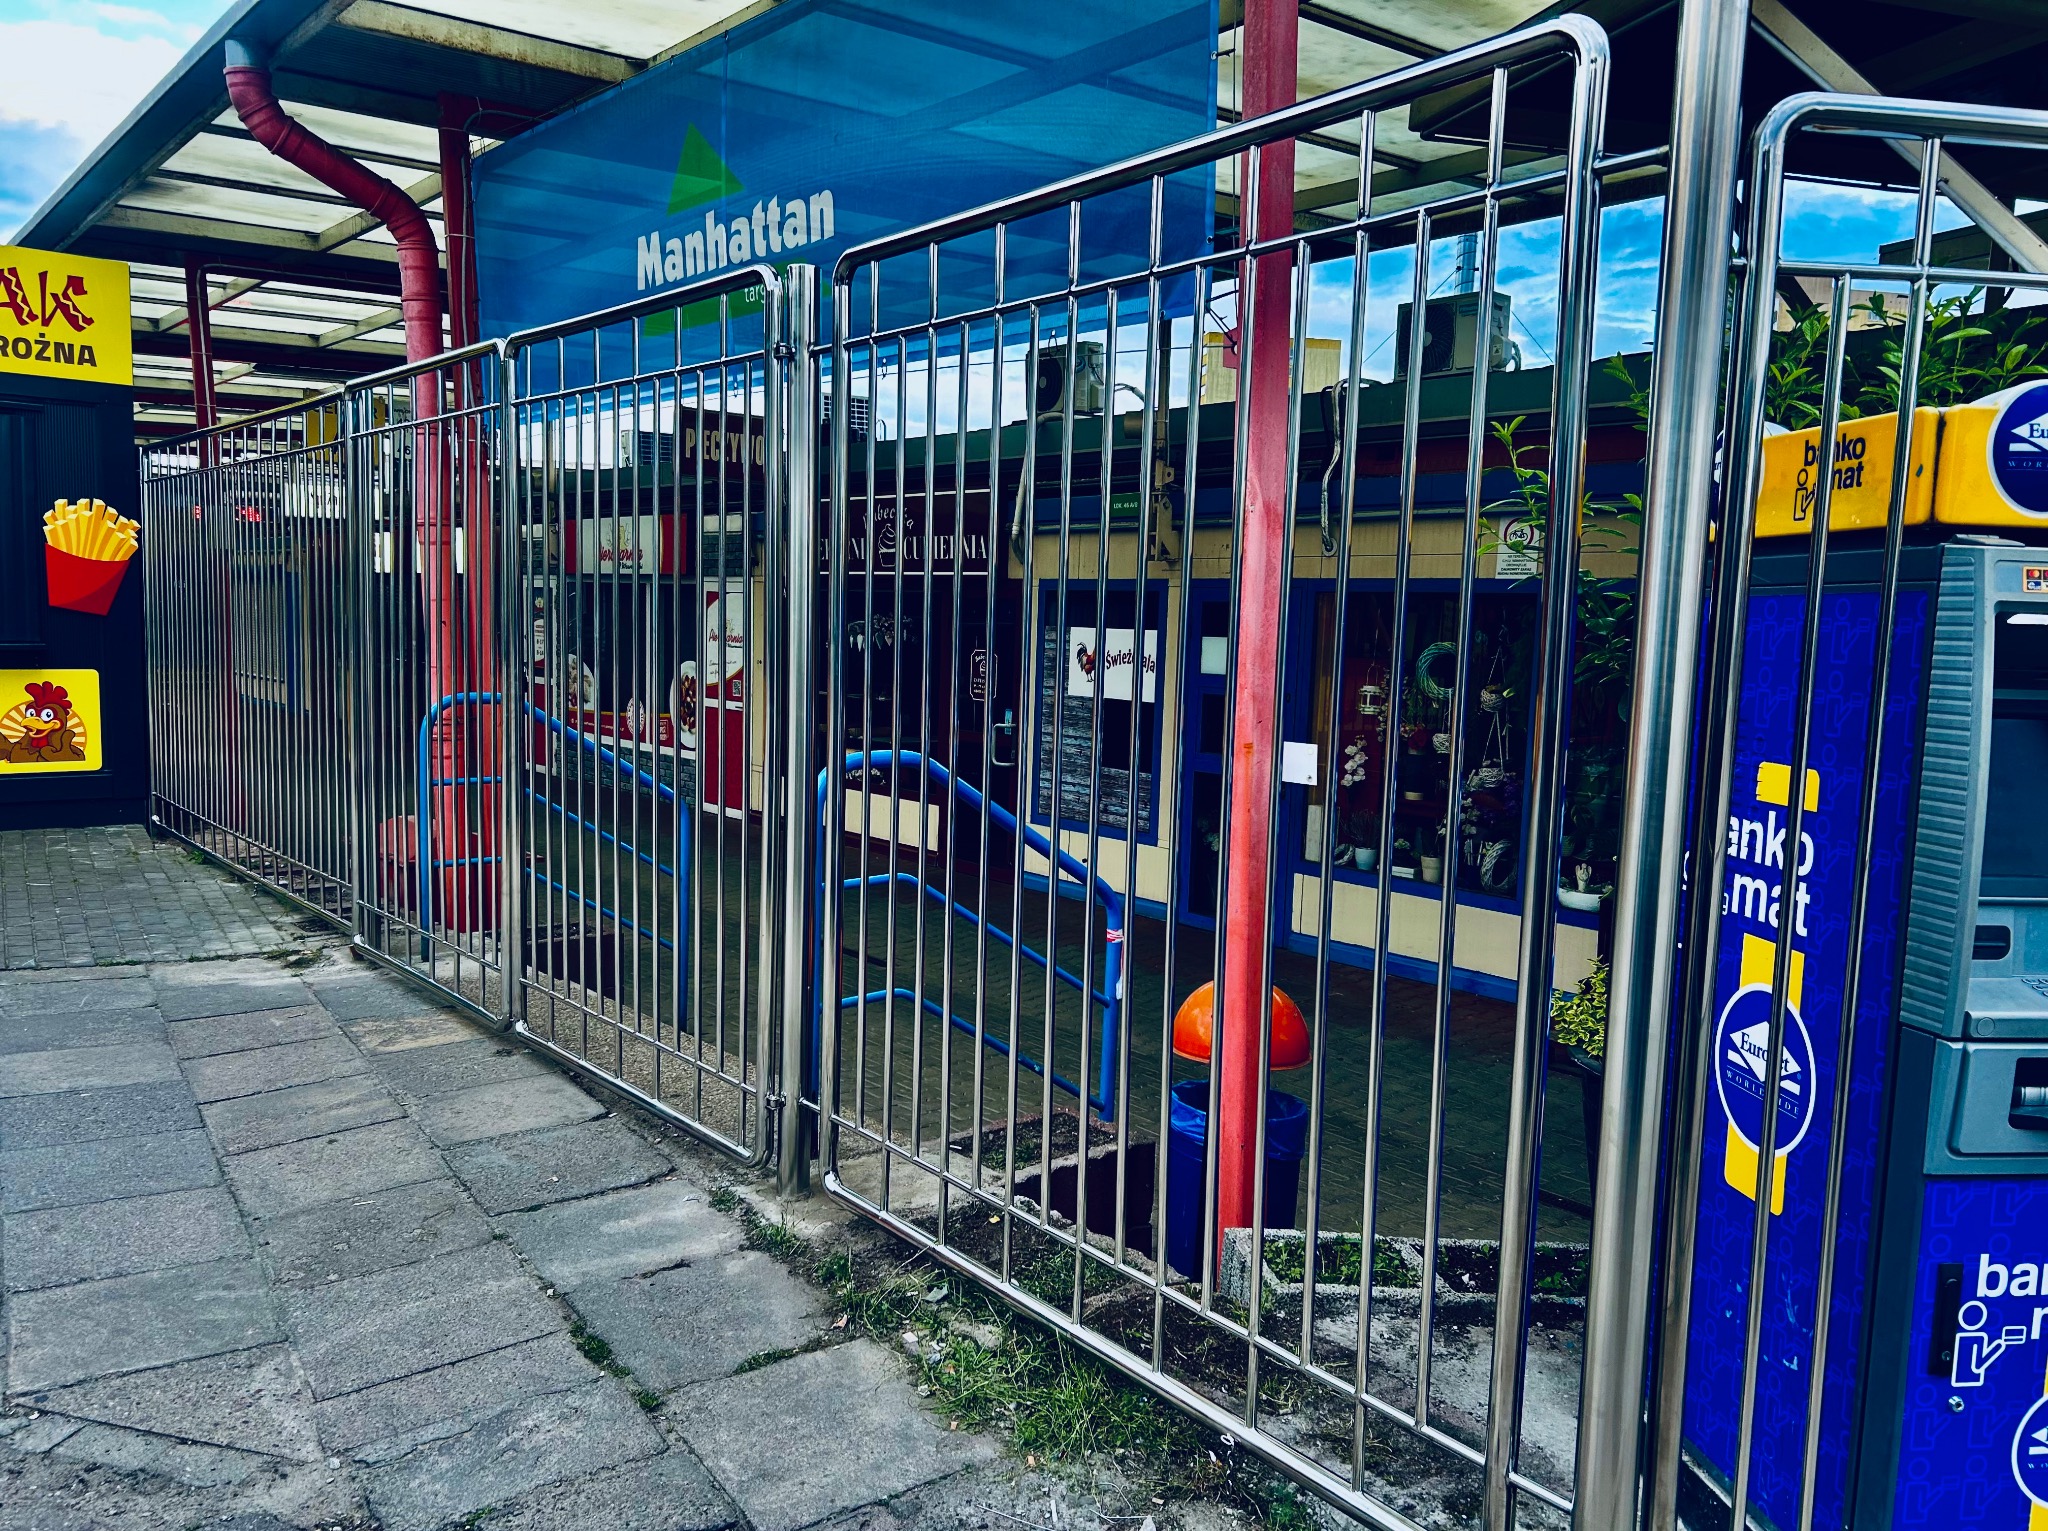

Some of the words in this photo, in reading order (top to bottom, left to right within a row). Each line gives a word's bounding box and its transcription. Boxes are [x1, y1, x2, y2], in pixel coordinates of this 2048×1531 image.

[637, 189, 835, 291] Manhattan
[1105, 649, 1134, 670] Śwież
[1142, 654, 1156, 673] aja
[1727, 811, 1814, 876] anko
[1726, 1070, 1799, 1115] WORLDIDE
